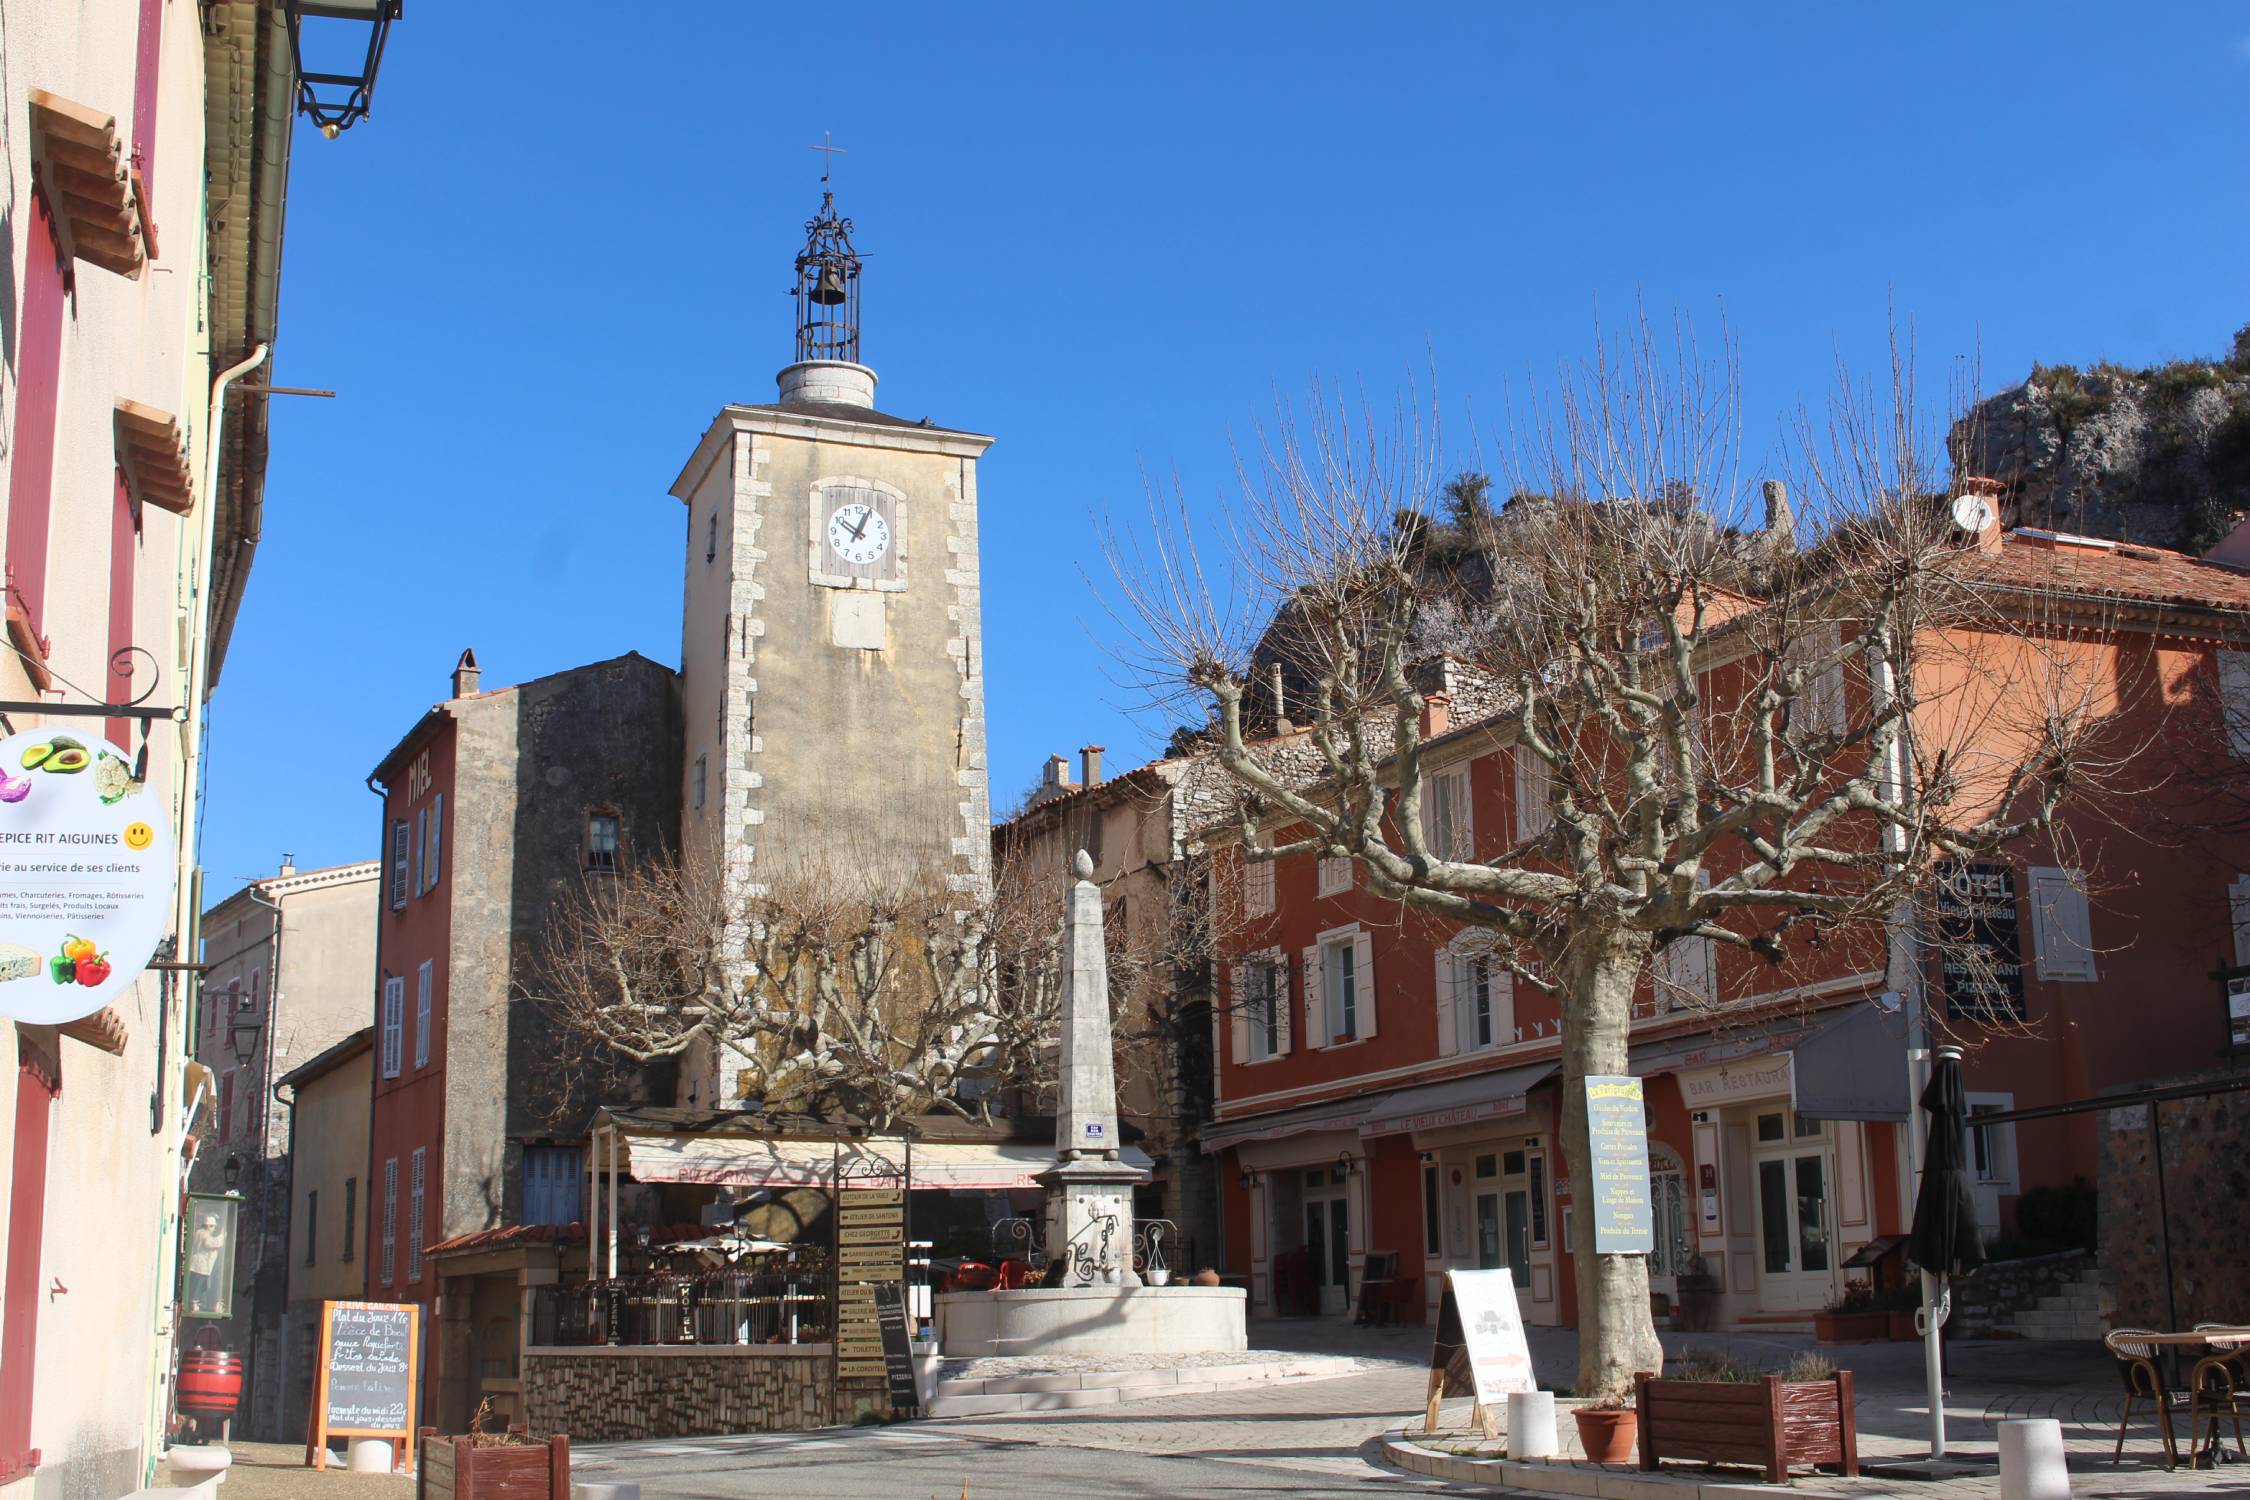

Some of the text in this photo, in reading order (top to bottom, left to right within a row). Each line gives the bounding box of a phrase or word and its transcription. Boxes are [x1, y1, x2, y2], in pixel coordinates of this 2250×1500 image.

[843, 508, 851, 516] 11
[854, 506, 864, 514] 12
[835, 516, 845, 525] 10
[877, 520, 883, 529] 2
[831, 527, 837, 535] 9
[880, 532, 887, 541] 3
[834, 538, 840, 547] 8
[876, 543, 883, 551] 4
[843, 548, 850, 557] 7
[855, 553, 862, 561] 6
[868, 551, 874, 559] 5
[36, 833, 56, 844] RIT
[59, 833, 118, 844] AIGUINES
[14, 864, 27, 872] au
[30, 862, 67, 872] service
[71, 862, 84, 872] de
[86, 864, 103, 872] ses
[106, 862, 140, 873] clients
[20, 891, 66, 900] Charcuteries,
[68, 891, 104, 900] Fromages,
[63, 902, 93, 910] Produits
[94, 902, 118, 910] Locaux
[1689, 1080, 1714, 1095] BAR
[678, 1168, 750, 1184] PIZZERIA
[681, 1287, 690, 1334] HOTEL
[352, 1310, 365, 1322] du
